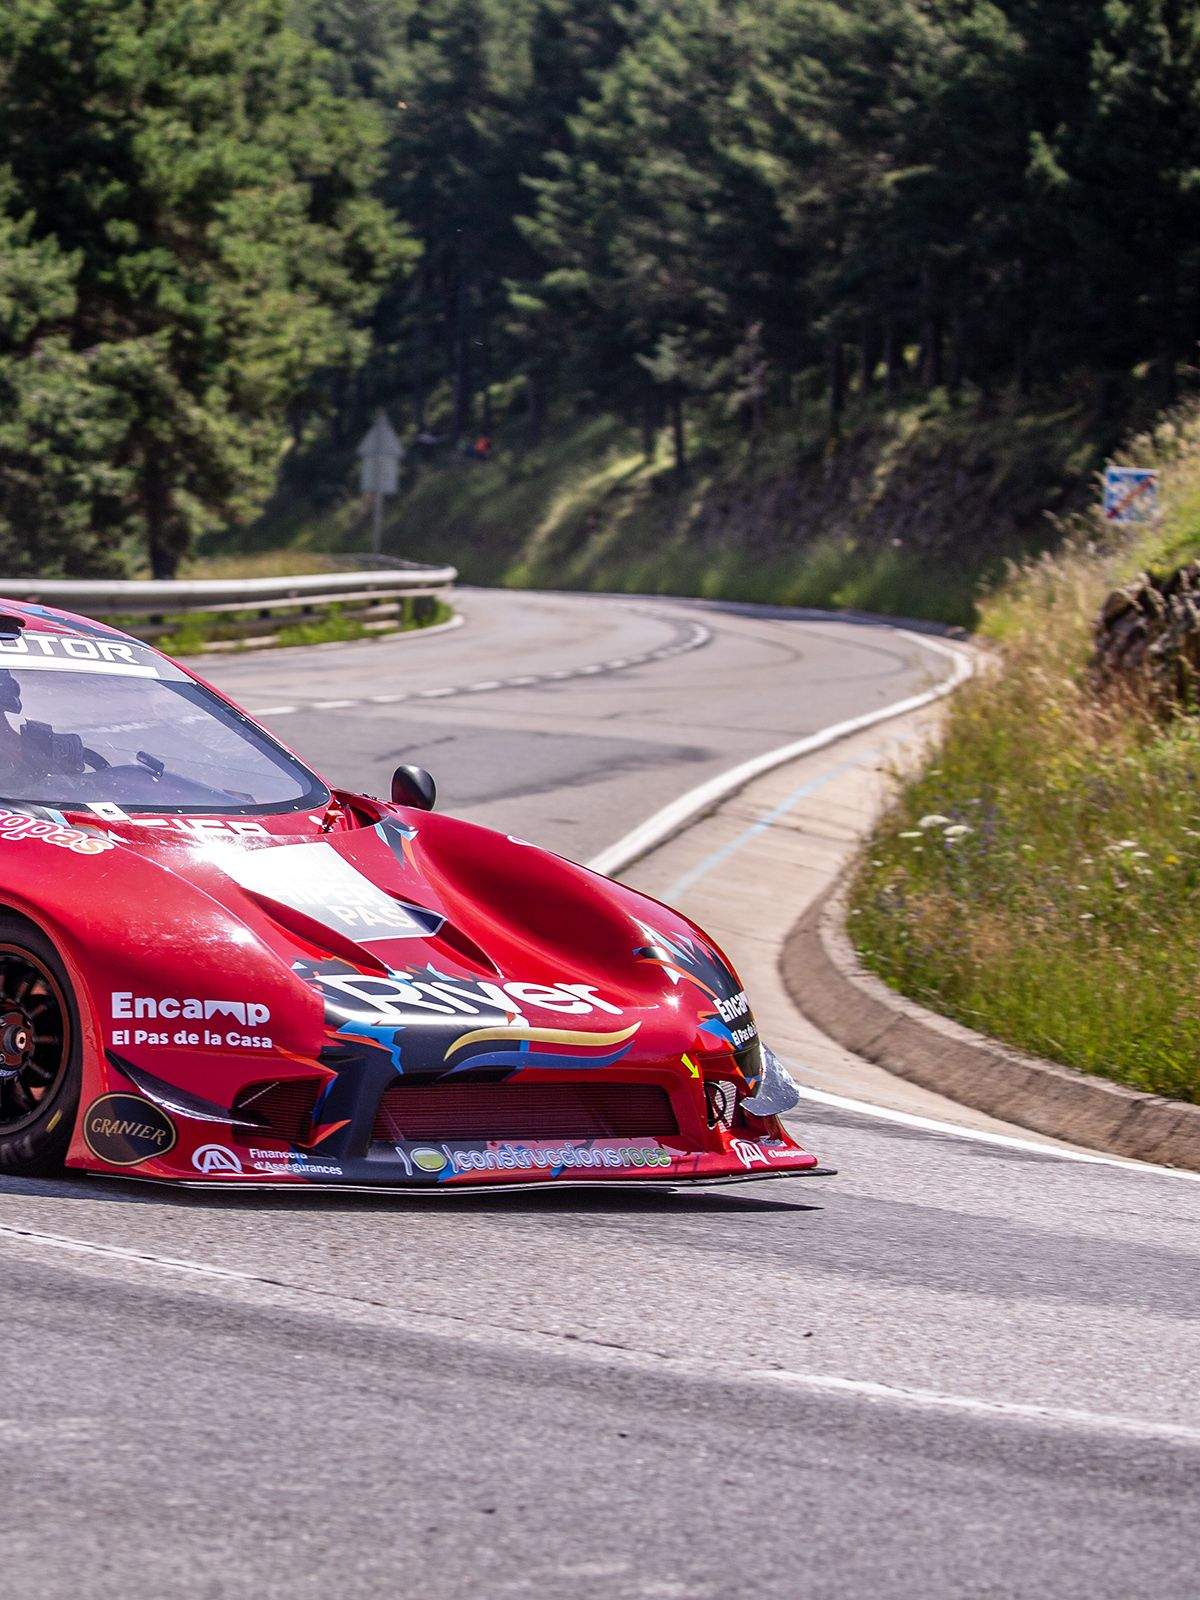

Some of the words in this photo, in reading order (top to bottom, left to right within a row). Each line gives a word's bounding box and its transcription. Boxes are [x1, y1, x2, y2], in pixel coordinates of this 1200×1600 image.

[326, 905, 417, 927] PAS
[315, 970, 624, 1015] River
[111, 992, 271, 1026] Encamp
[112, 1030, 130, 1046] El
[134, 1030, 169, 1046] Pas
[173, 1030, 199, 1046] de
[204, 1030, 222, 1046] la
[225, 1031, 273, 1049] Casa
[91, 1117, 166, 1146] GRANIER
[253, 1160, 343, 1175] d'Assegurances
